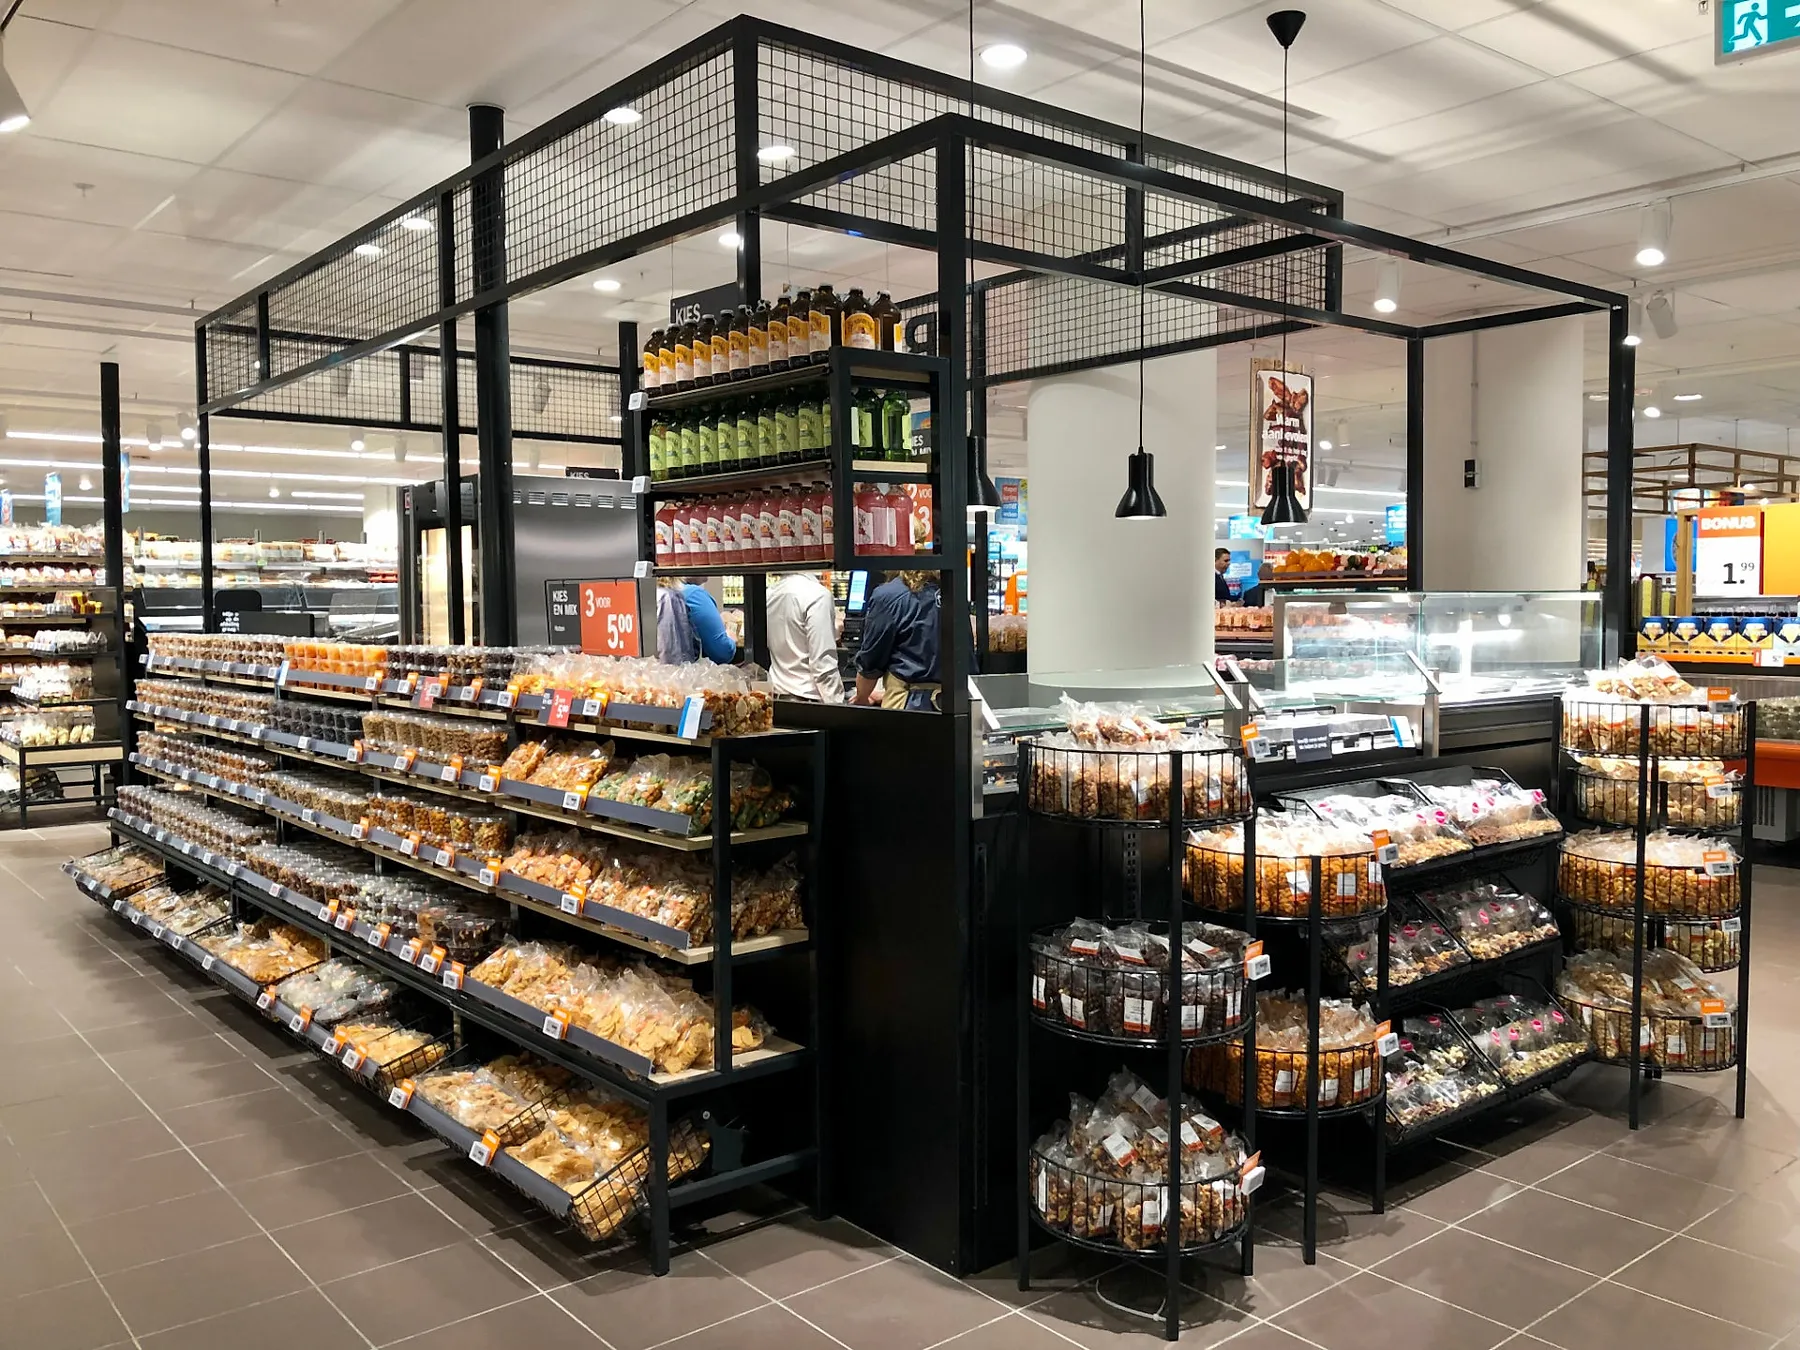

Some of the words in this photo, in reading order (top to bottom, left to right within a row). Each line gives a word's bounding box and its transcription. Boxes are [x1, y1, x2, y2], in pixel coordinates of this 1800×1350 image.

[675, 303, 701, 326] KIES
[1701, 515, 1756, 531] BONUS
[1723, 562, 1755, 585] 1.99
[552, 590, 568, 602] KIES
[585, 588, 595, 617] 3
[595, 597, 611, 608] VOOR
[553, 605, 563, 616] EN
[564, 604, 578, 616] MIX
